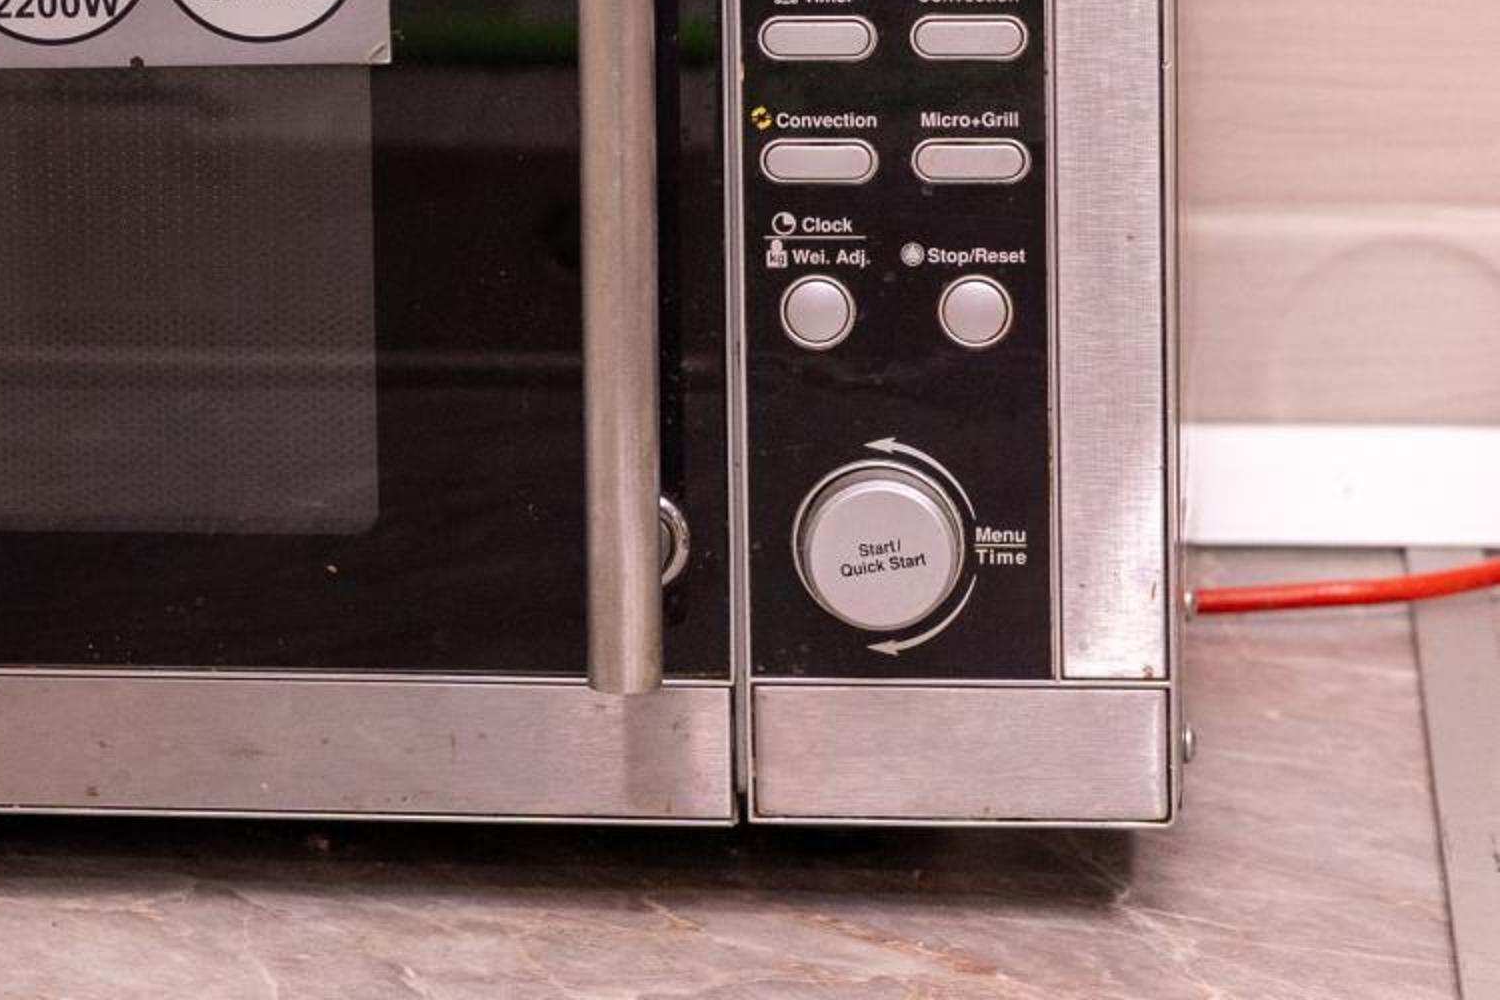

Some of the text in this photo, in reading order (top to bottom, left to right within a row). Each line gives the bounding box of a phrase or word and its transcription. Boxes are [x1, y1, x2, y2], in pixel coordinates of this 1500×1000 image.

[775, 112, 878, 129] Convection
[920, 111, 1019, 128] Micro+Grill
[802, 216, 853, 232] Clock
[791, 249, 831, 264] Wei.
[835, 248, 871, 268] Adj.
[927, 247, 1026, 265] Stop/Reset
[974, 526, 1026, 543] Menu
[975, 548, 1027, 565] Time
[840, 553, 926, 578] Quick Start
